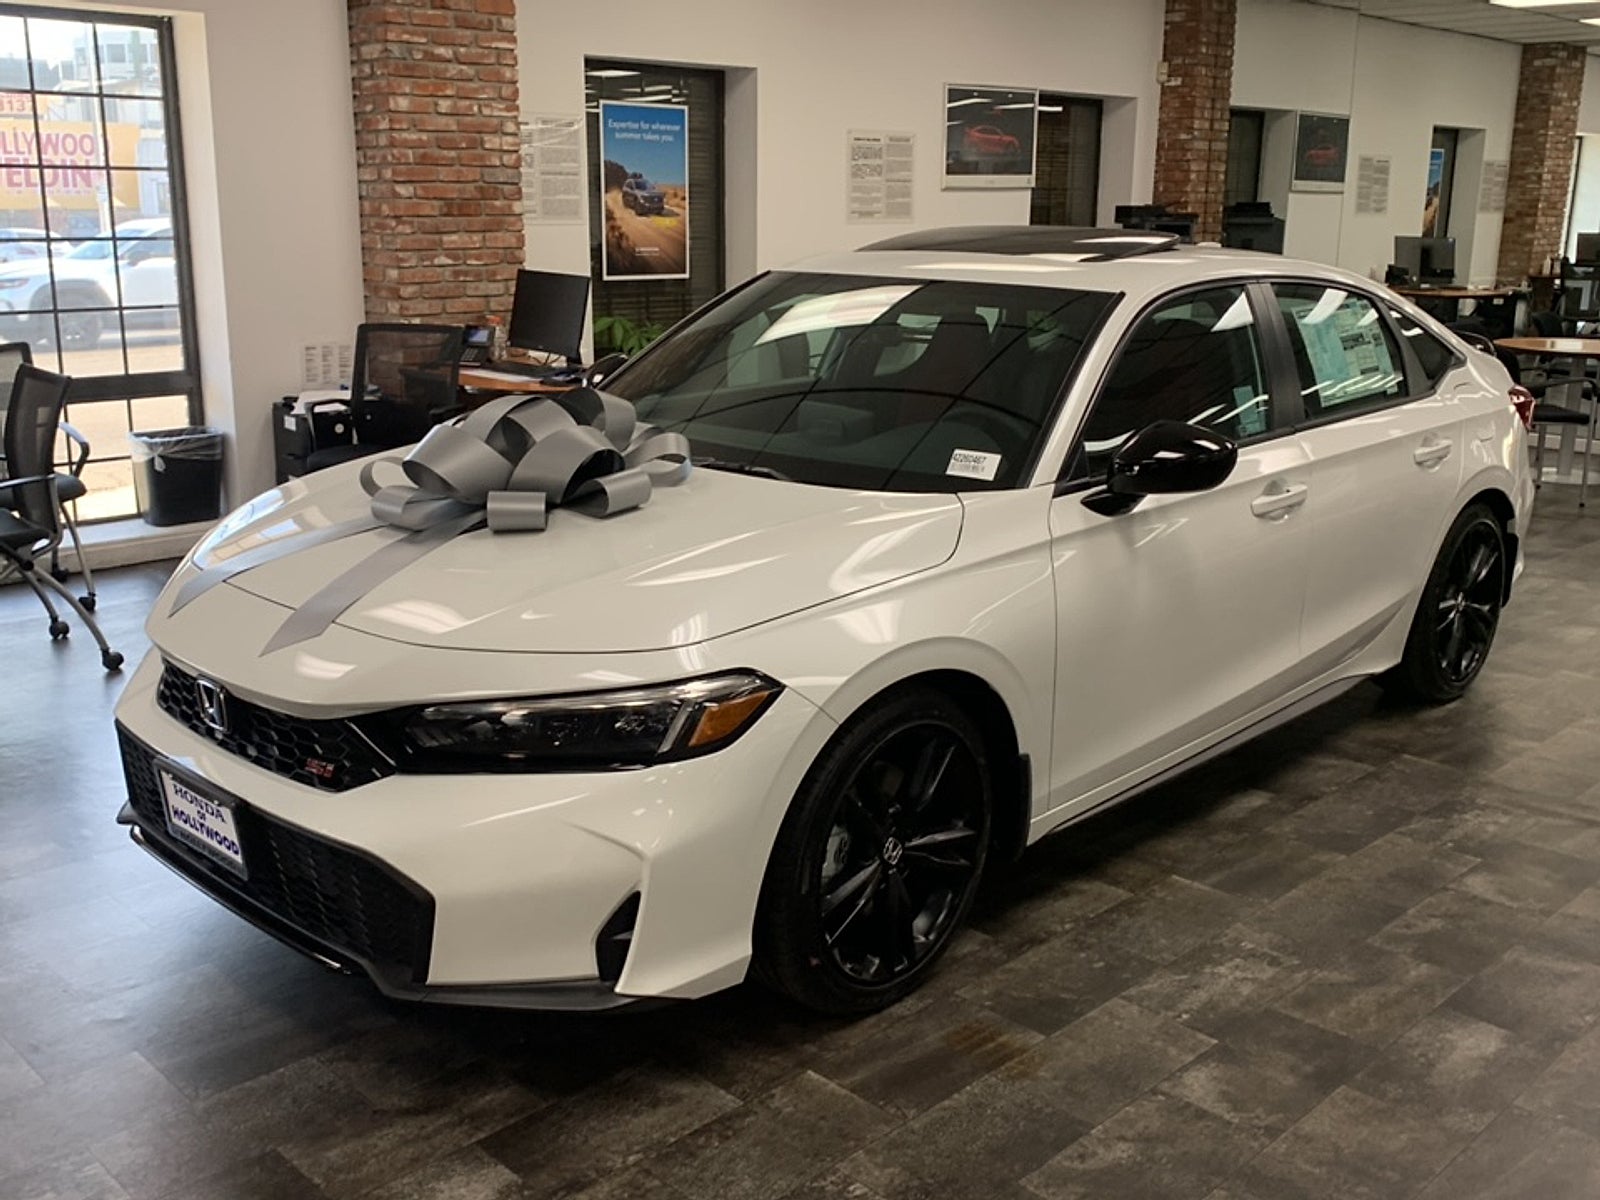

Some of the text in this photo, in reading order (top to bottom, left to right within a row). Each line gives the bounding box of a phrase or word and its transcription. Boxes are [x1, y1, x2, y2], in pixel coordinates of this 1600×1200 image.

[608, 118, 680, 131] Expertise for wherever
[642, 131, 659, 140] takes
[0, 131, 96, 156] LLYWOO
[0, 157, 98, 188] ELDIN
[172, 783, 227, 824] HONDA
[172, 805, 240, 855] HOLLYWOOD
